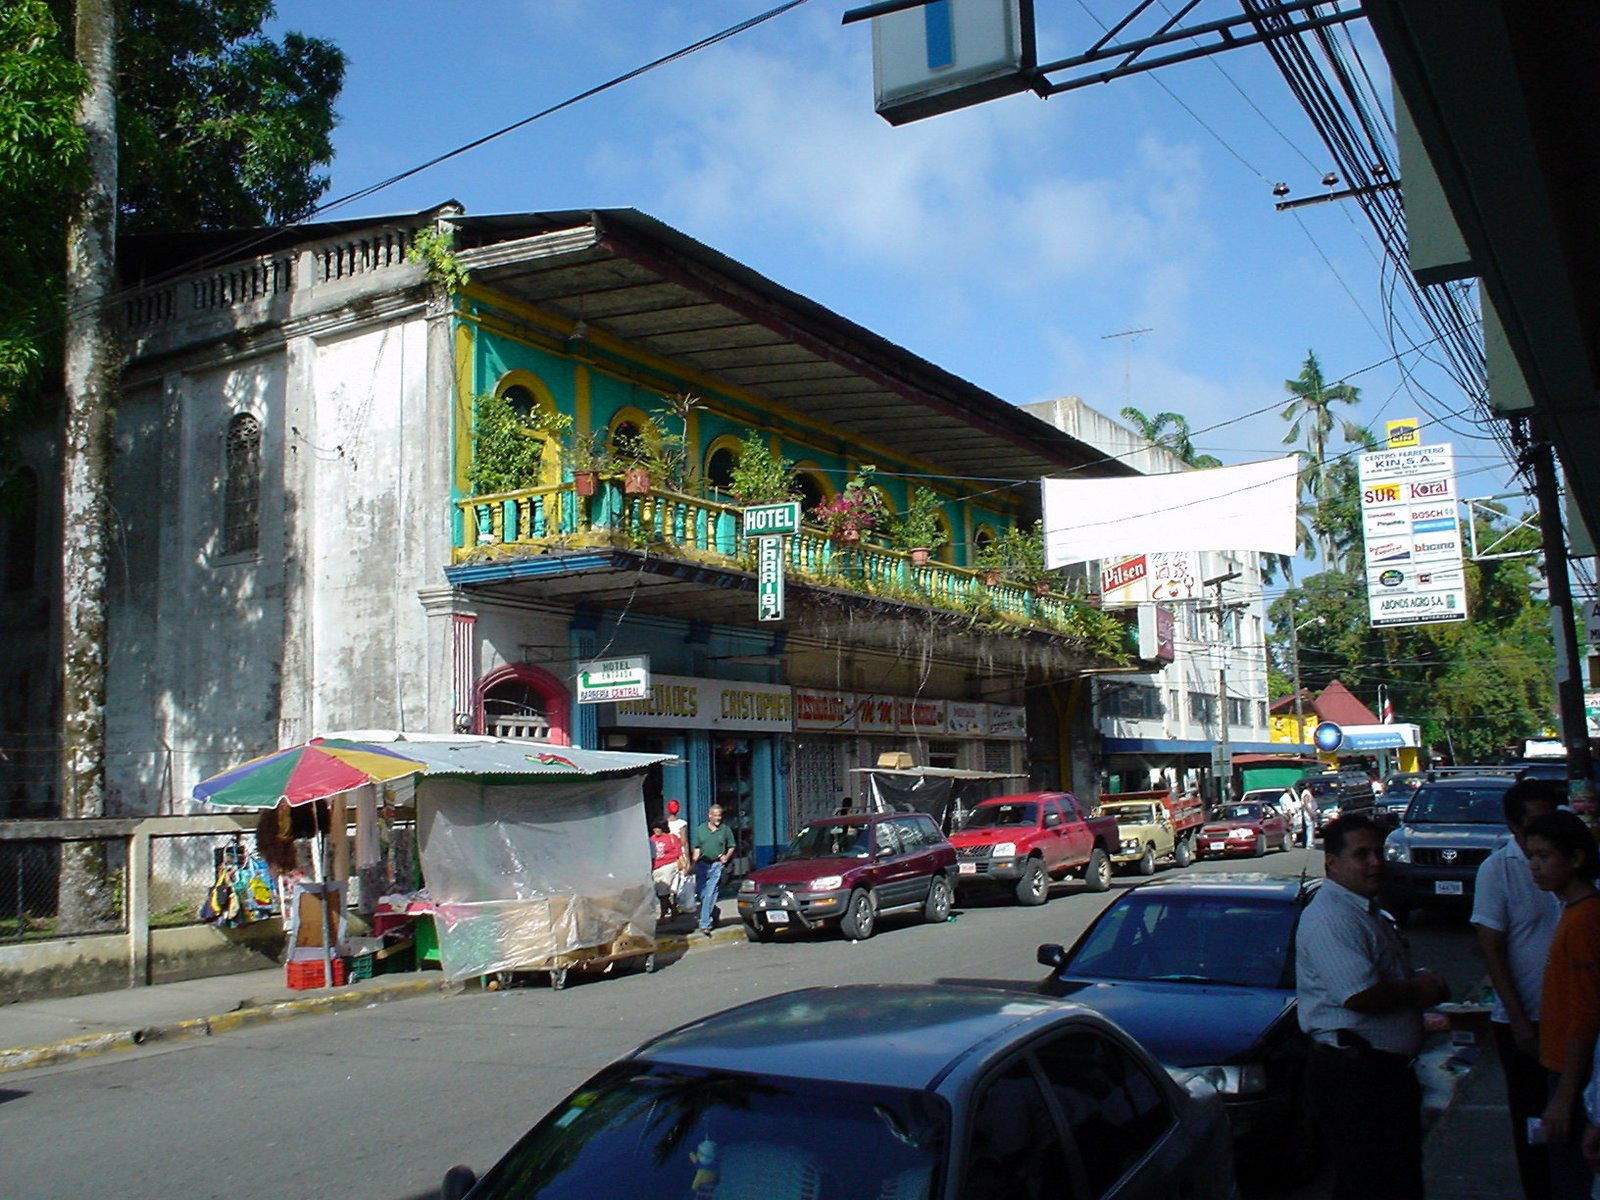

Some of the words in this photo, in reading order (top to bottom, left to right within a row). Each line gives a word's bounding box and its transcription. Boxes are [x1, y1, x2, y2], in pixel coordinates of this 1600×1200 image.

[1364, 487, 1396, 503] SUR
[1410, 479, 1448, 498] Koral
[746, 509, 793, 531] HOTEL
[1411, 509, 1443, 519] BOSCH
[1104, 563, 1144, 590] Pilsen
[1380, 598, 1409, 610] ABONOS
[1410, 596, 1430, 607] AGRO
[602, 661, 631, 672] HOTEL
[611, 687, 640, 699] CENTRAL
